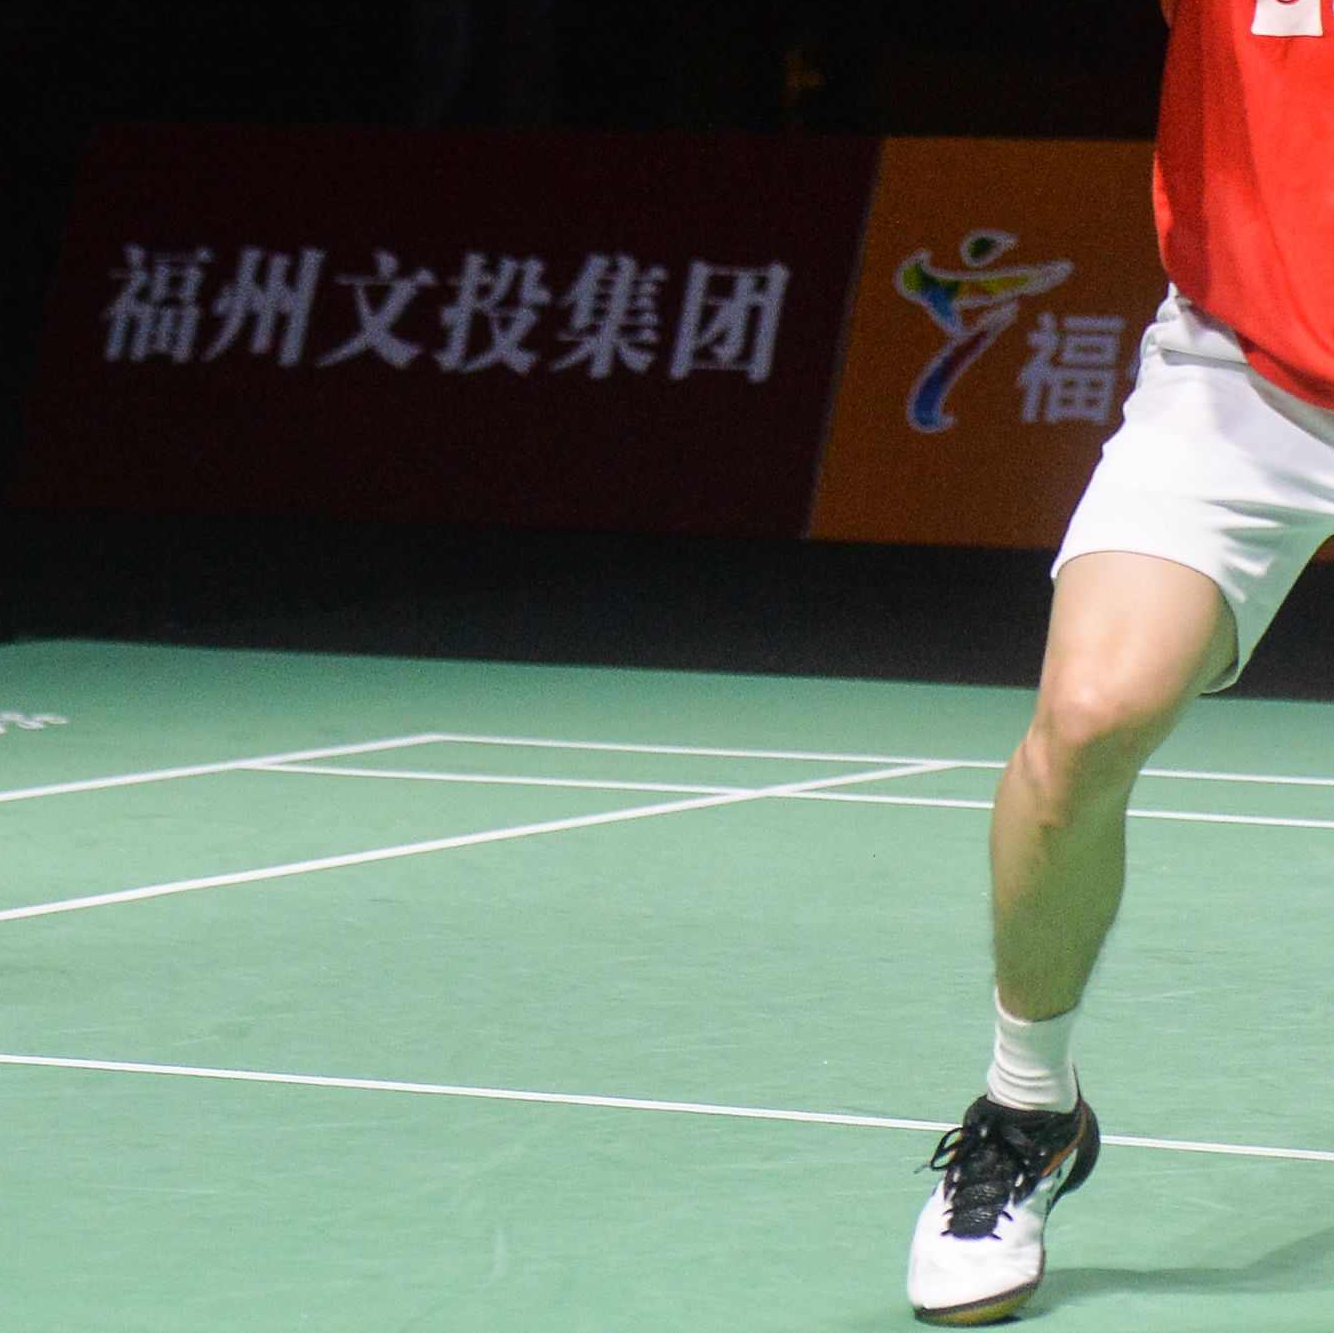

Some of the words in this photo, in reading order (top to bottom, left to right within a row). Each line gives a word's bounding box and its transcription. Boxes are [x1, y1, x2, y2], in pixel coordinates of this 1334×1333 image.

[101, 243, 790, 384] 福州文投集团
